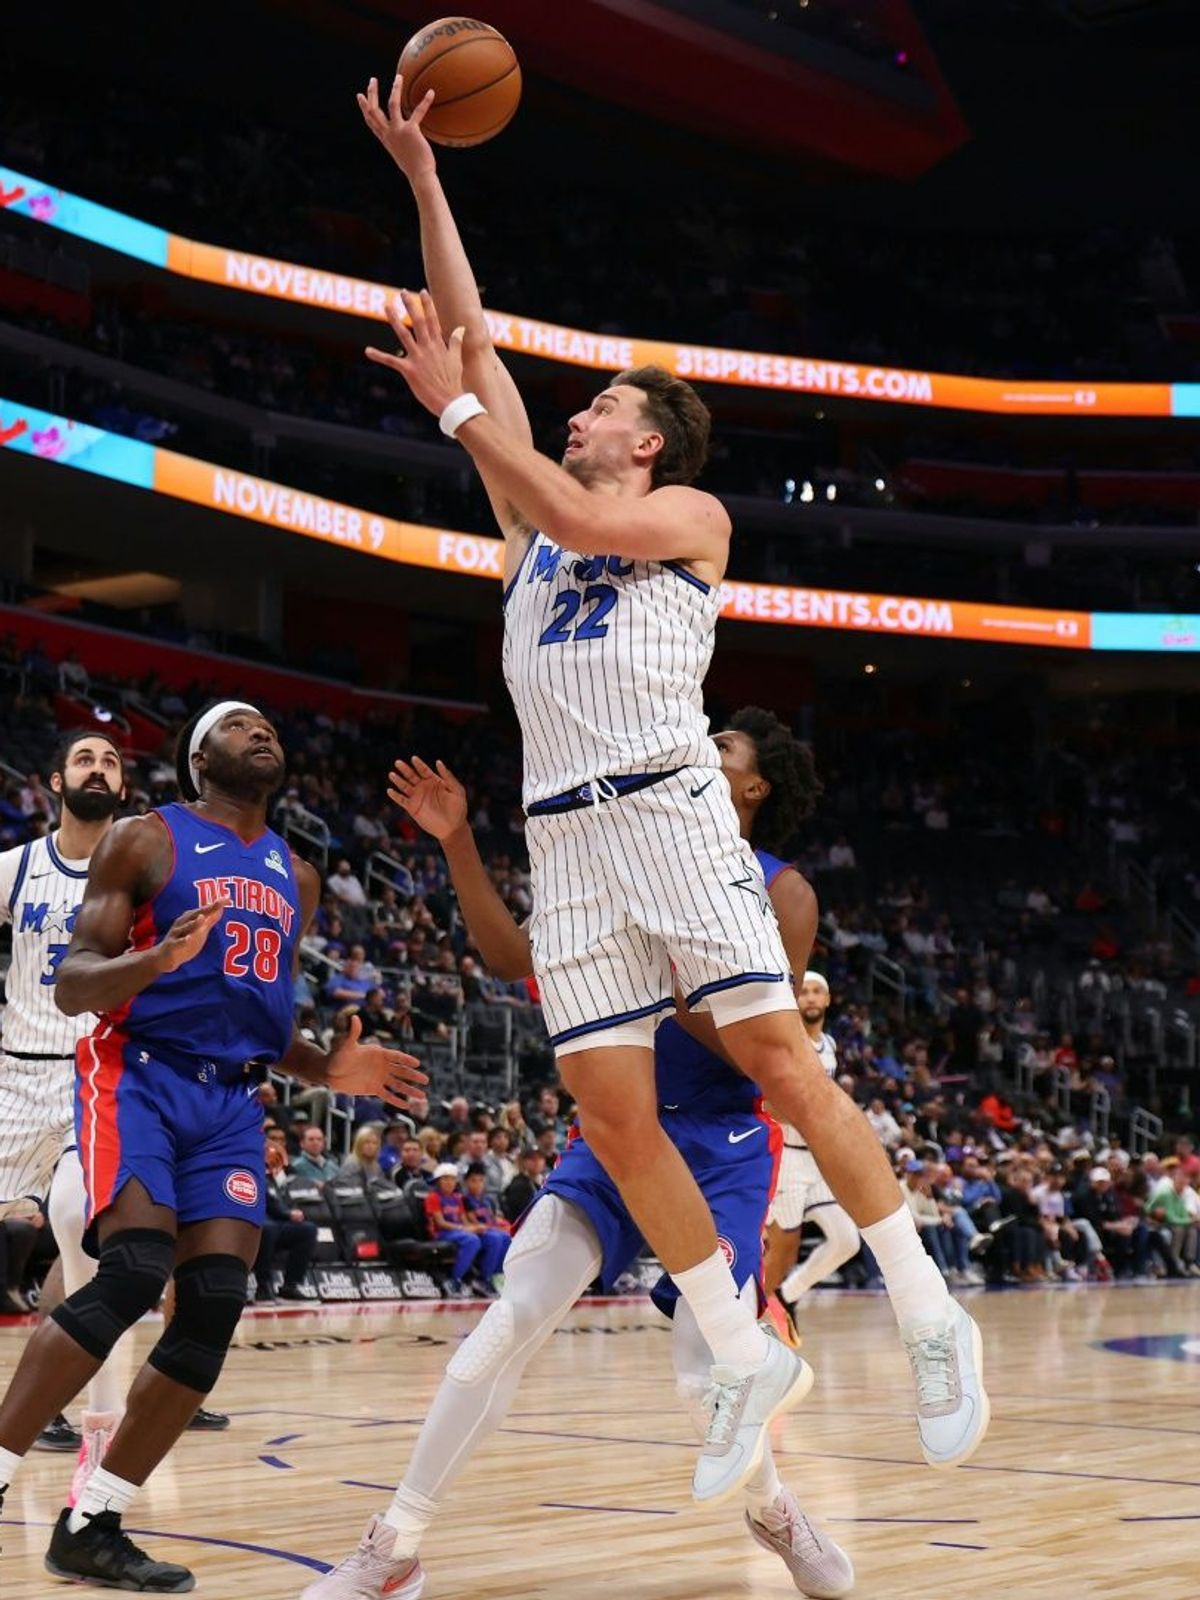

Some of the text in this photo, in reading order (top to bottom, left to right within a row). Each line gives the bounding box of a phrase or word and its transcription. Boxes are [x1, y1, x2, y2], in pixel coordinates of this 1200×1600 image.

[226, 253, 386, 314] NOVEMBER
[519, 321, 632, 368] THEATRE
[675, 349, 933, 401] 313PRESENTS.COM
[213, 470, 363, 545] NOVEMBER
[368, 517, 385, 550] 9
[437, 534, 499, 573] FOX
[718, 582, 954, 632] PRESENTS.COM
[538, 583, 618, 647] 22
[193, 876, 295, 937] DETROIT
[40, 944, 69, 986] 3
[223, 920, 281, 983] 28
